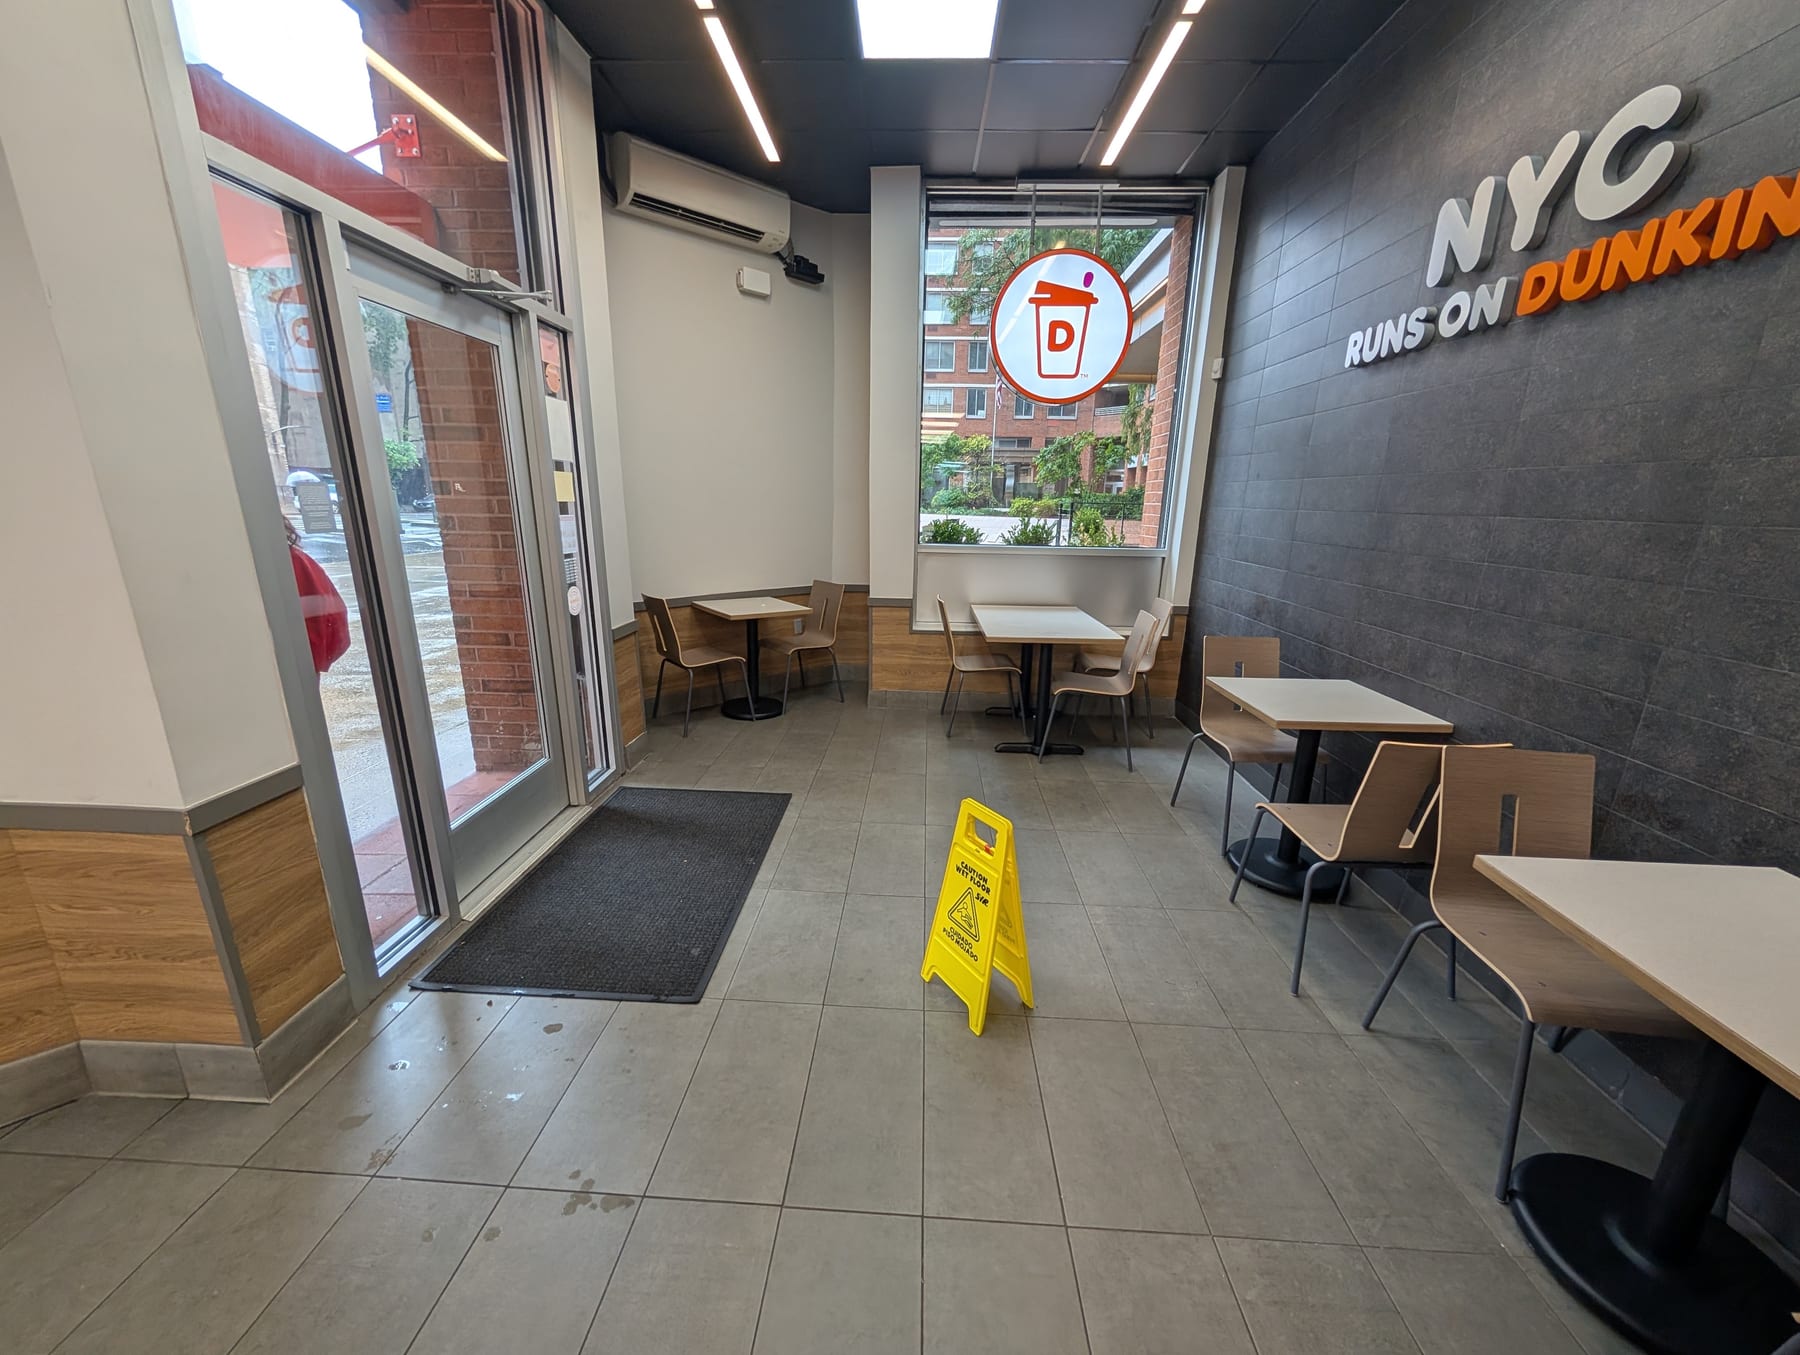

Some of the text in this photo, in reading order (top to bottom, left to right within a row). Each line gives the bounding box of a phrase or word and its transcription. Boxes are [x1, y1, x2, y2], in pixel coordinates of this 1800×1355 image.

[1426, 84, 1686, 288] NYC
[1343, 170, 1800, 369] RUNS ON DUNKIN
[1048, 319, 1075, 352] D
[955, 863, 991, 896] WET FLOOR
[960, 861, 988, 885] CAUTION
[942, 927, 978, 962] PISO MOJADO
[949, 926, 973, 950] CUIDADO
